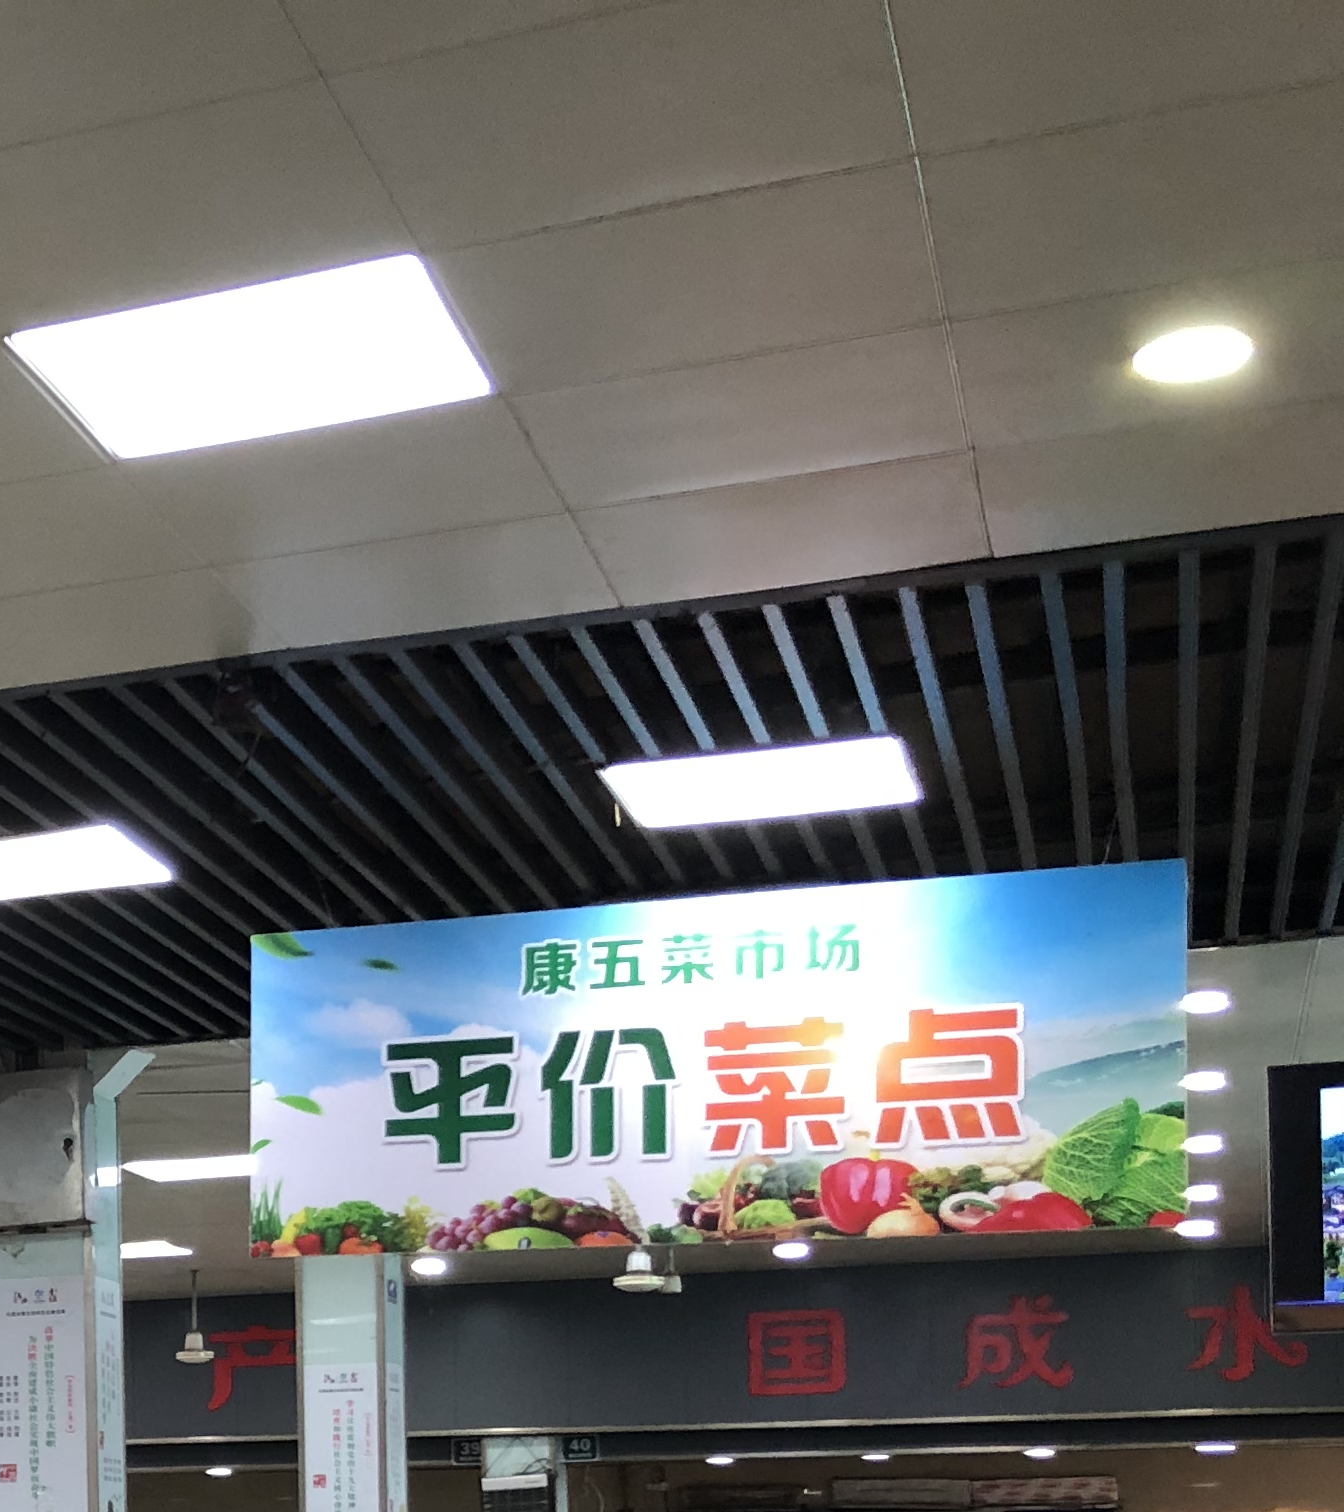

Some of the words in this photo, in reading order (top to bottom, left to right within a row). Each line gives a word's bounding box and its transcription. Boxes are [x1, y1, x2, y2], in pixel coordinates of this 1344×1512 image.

[520, 923, 863, 998] 康五菜市场
[382, 1003, 1025, 1163] 平价菜点
[568, 1438, 592, 1452] 40
